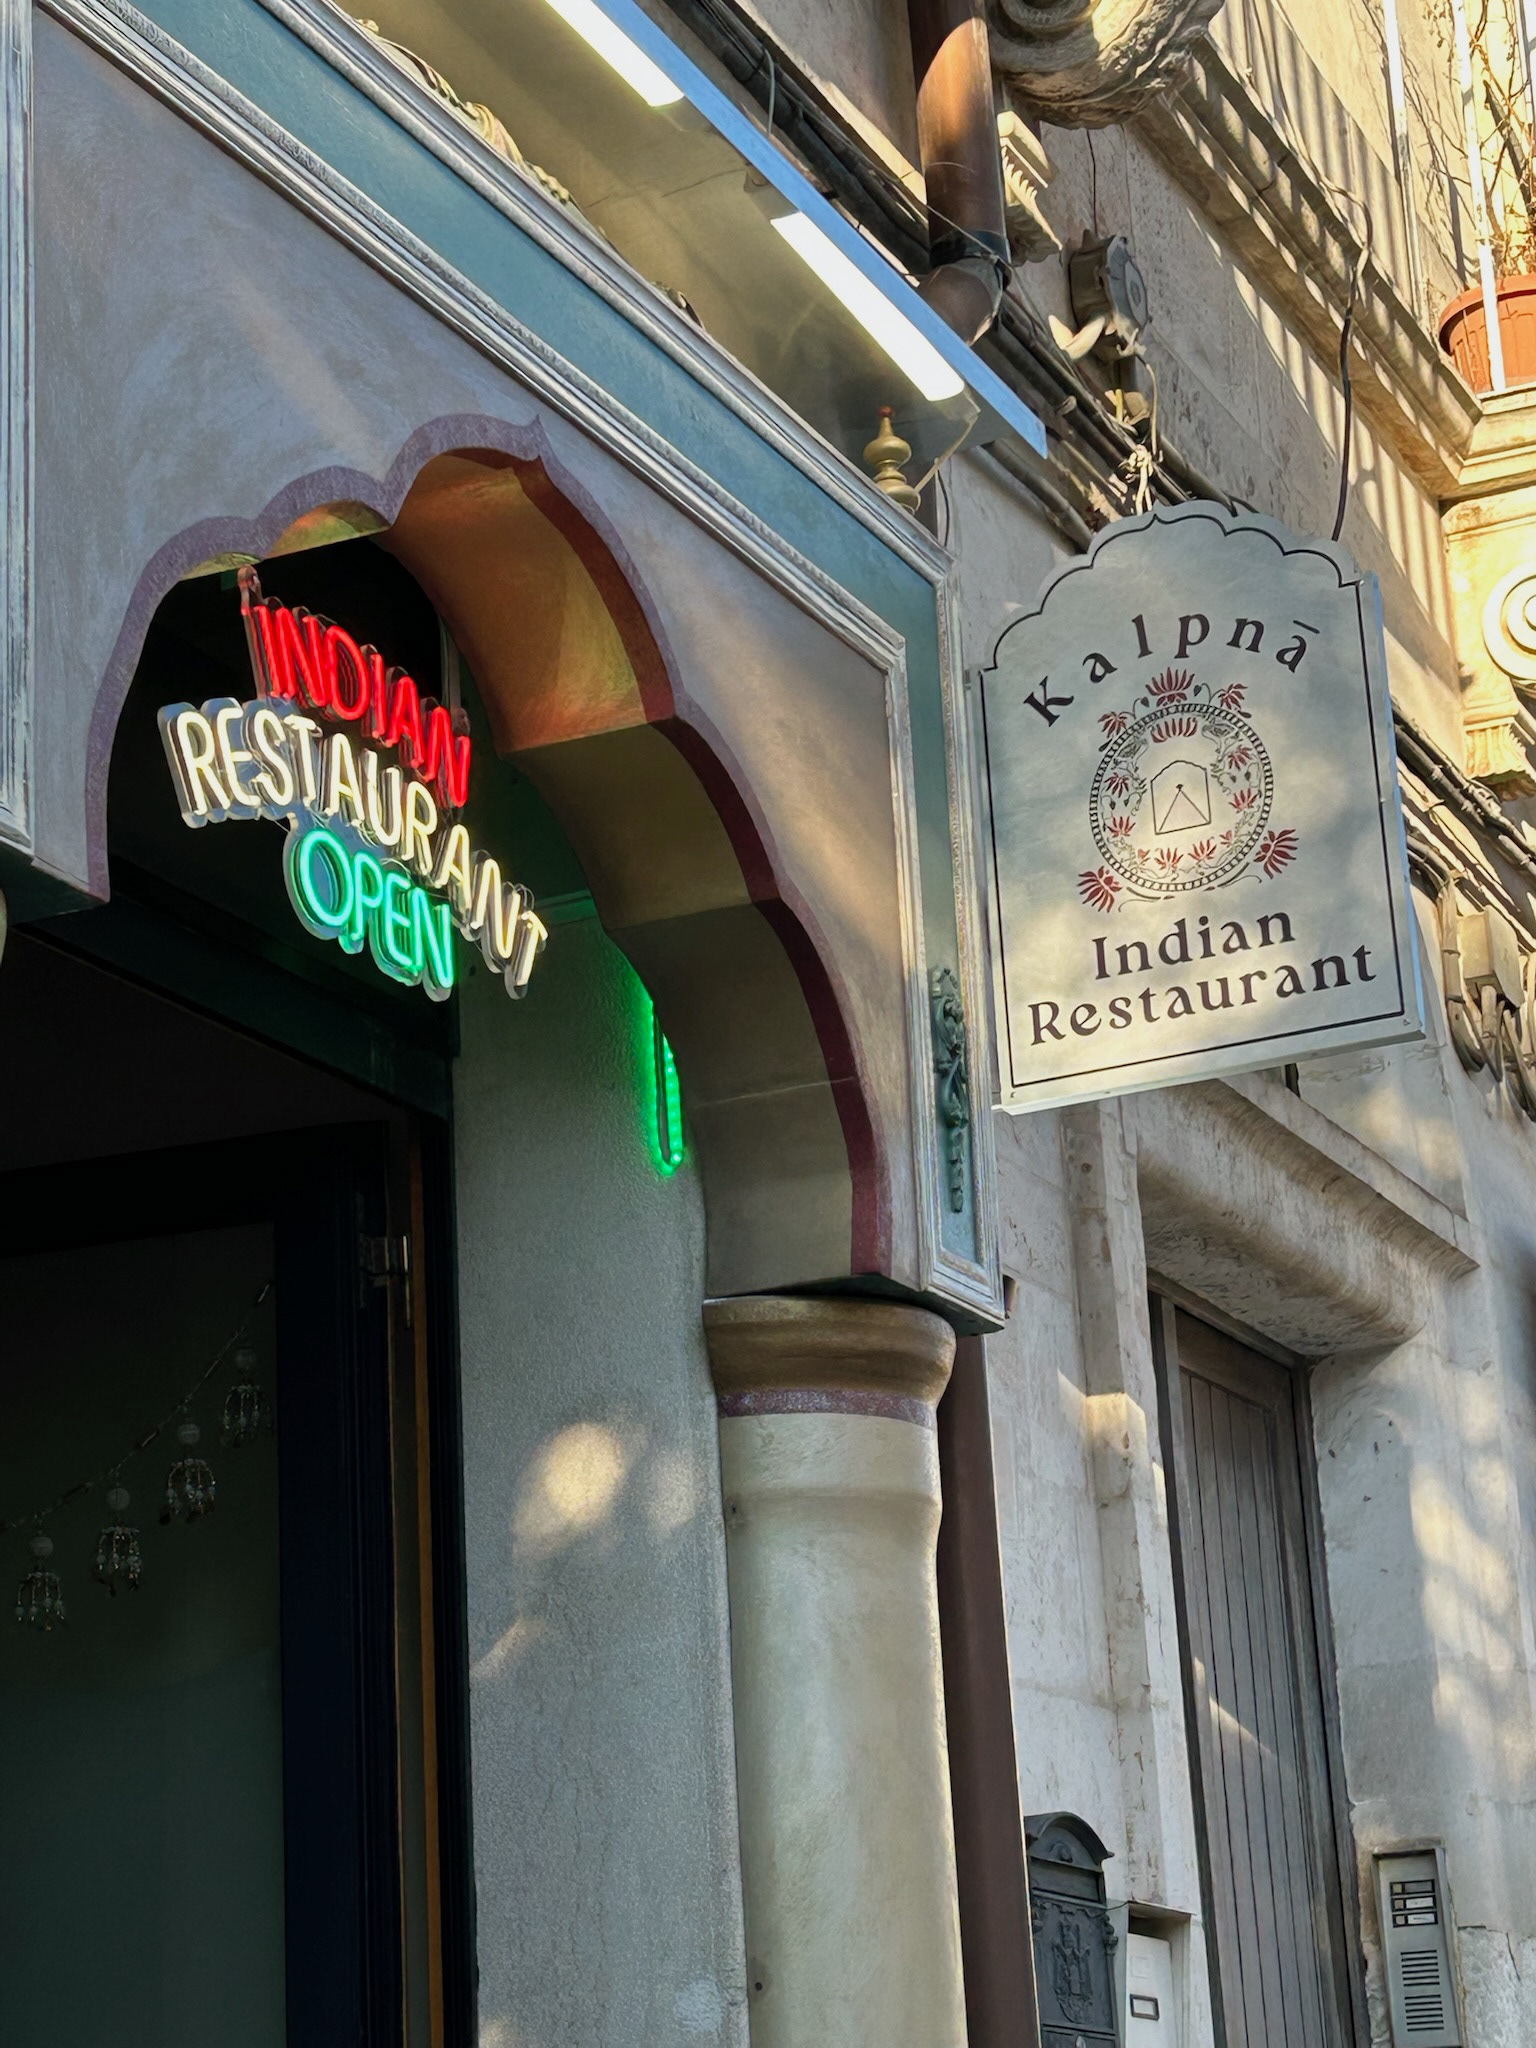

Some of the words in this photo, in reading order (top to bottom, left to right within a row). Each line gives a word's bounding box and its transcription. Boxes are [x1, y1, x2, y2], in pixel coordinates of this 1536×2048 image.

[252, 604, 472, 809] INDIAN
[168, 706, 549, 988] RESTAURANT
[297, 828, 454, 990] OPEN
[1028, 944, 1378, 1046] Restaurant
[1093, 912, 1296, 980] Indian
